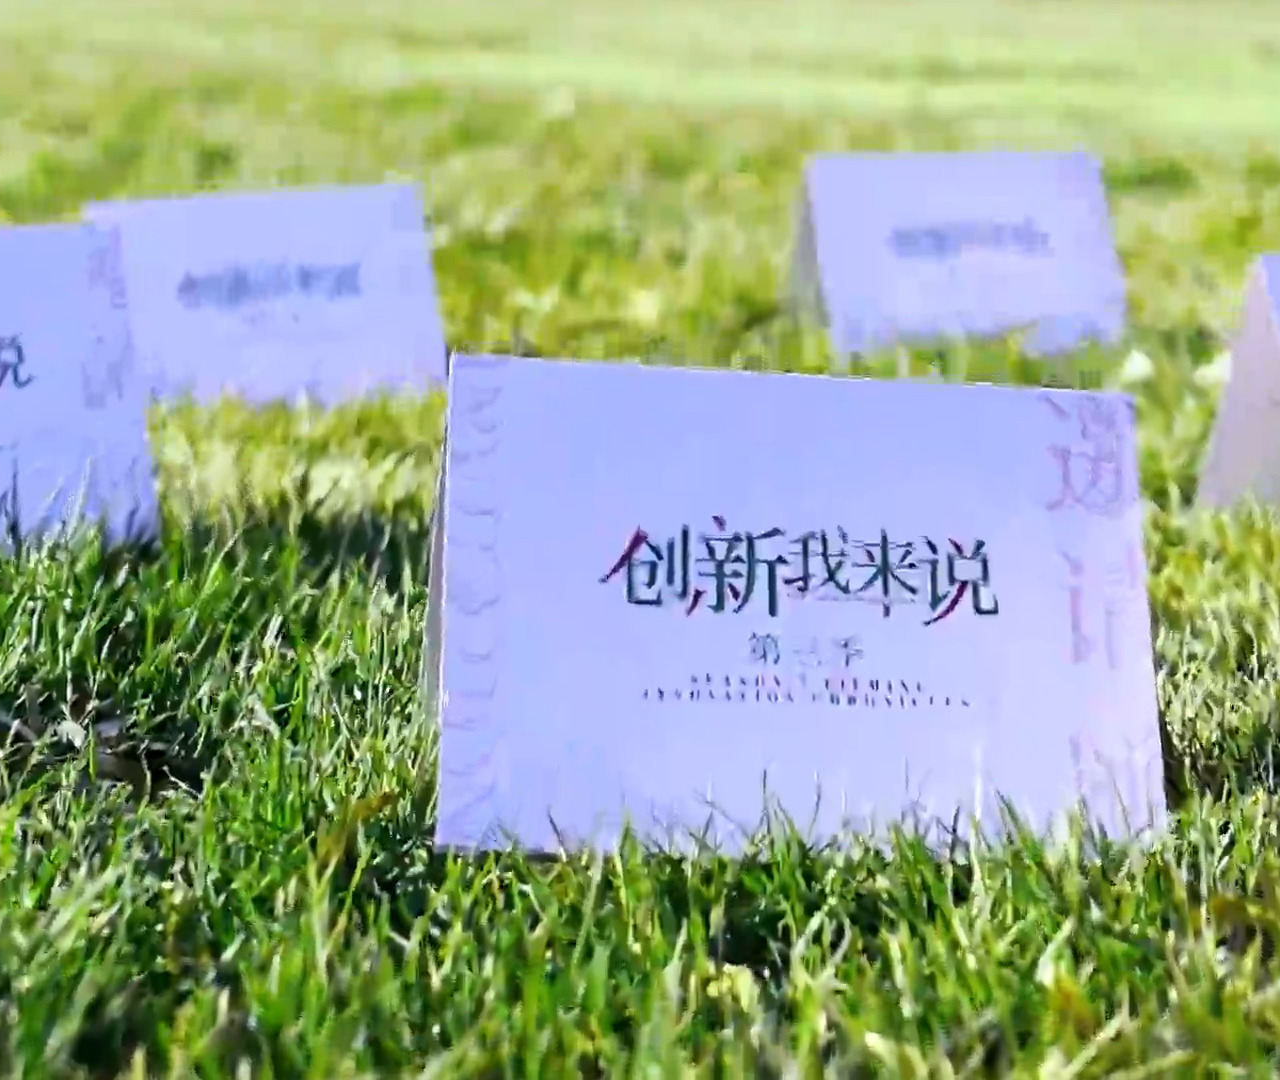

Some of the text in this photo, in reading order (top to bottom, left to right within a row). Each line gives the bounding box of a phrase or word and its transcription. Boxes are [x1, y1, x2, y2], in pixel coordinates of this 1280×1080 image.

[600, 515, 998, 626] 创新我来说
